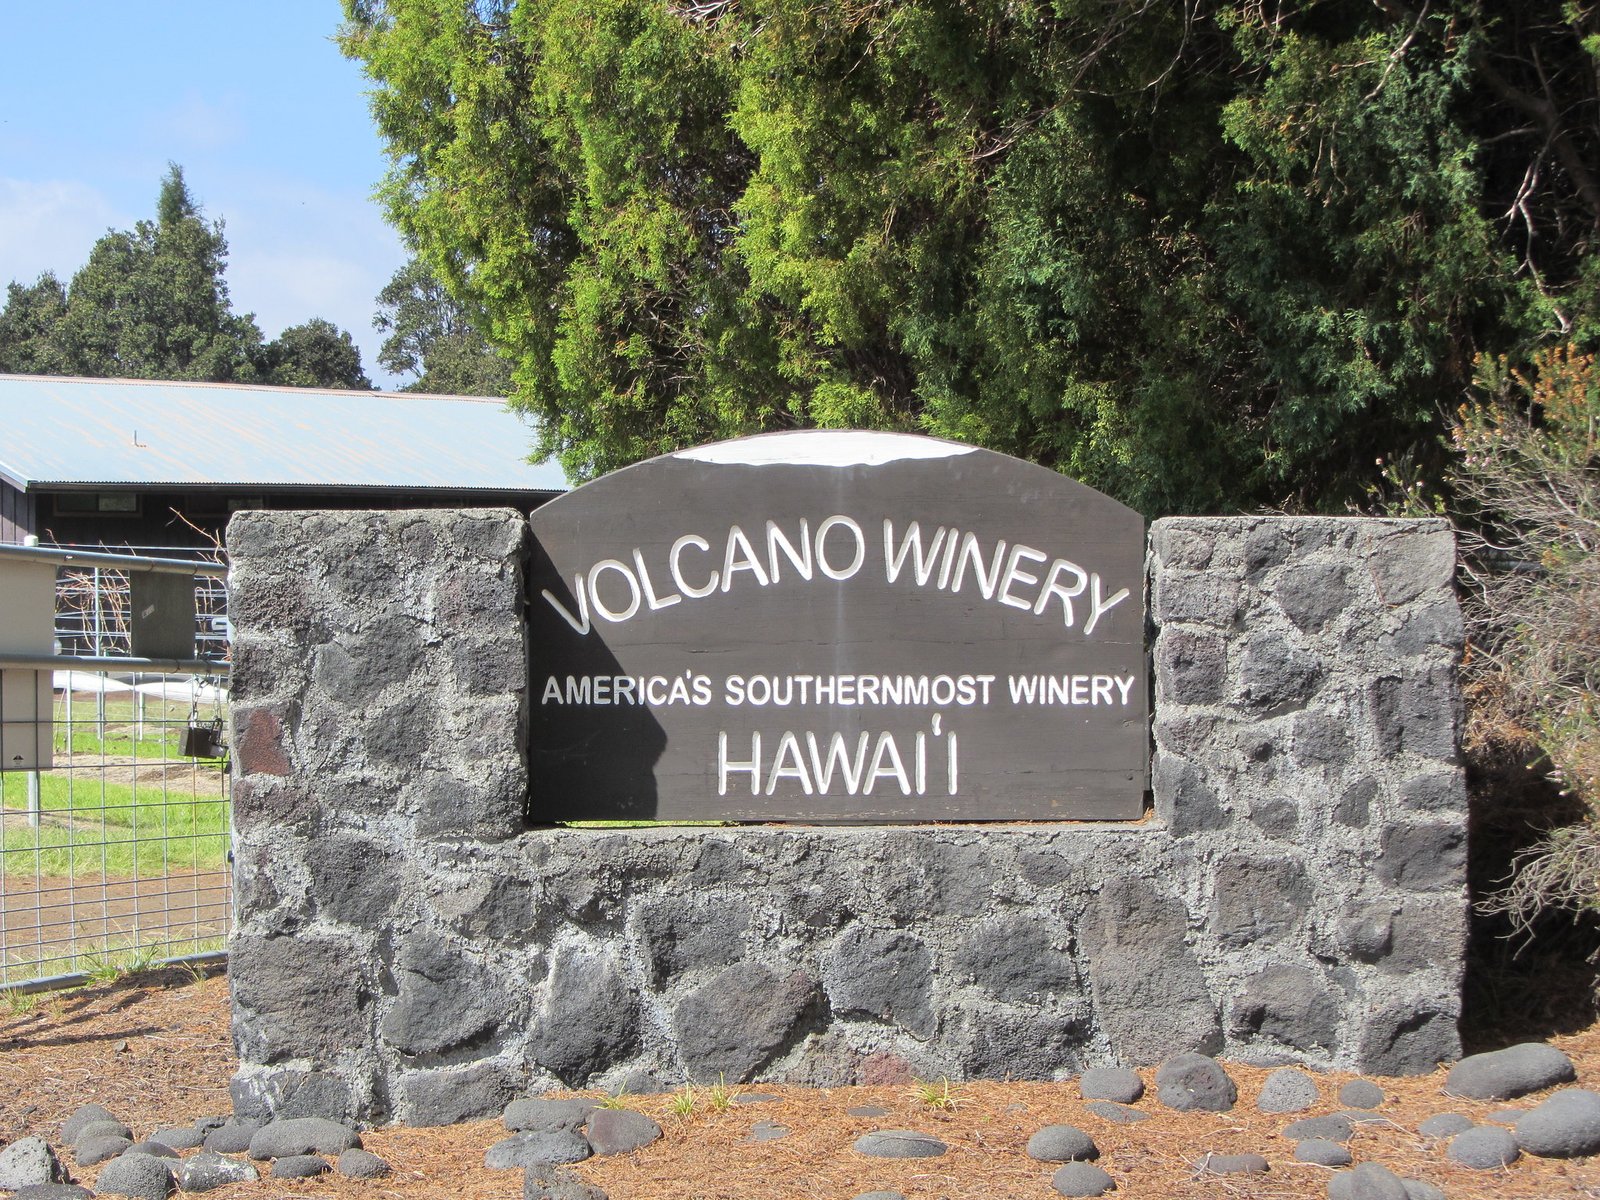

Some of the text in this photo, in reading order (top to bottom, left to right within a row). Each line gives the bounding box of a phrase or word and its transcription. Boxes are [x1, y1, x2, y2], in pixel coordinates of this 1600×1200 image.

[541, 515, 1130, 635] VOLCANO WINERY
[541, 669, 1136, 706] AMERICA'S SOUTHERNMOST WINERY
[717, 712, 959, 796] HAWAI'I
